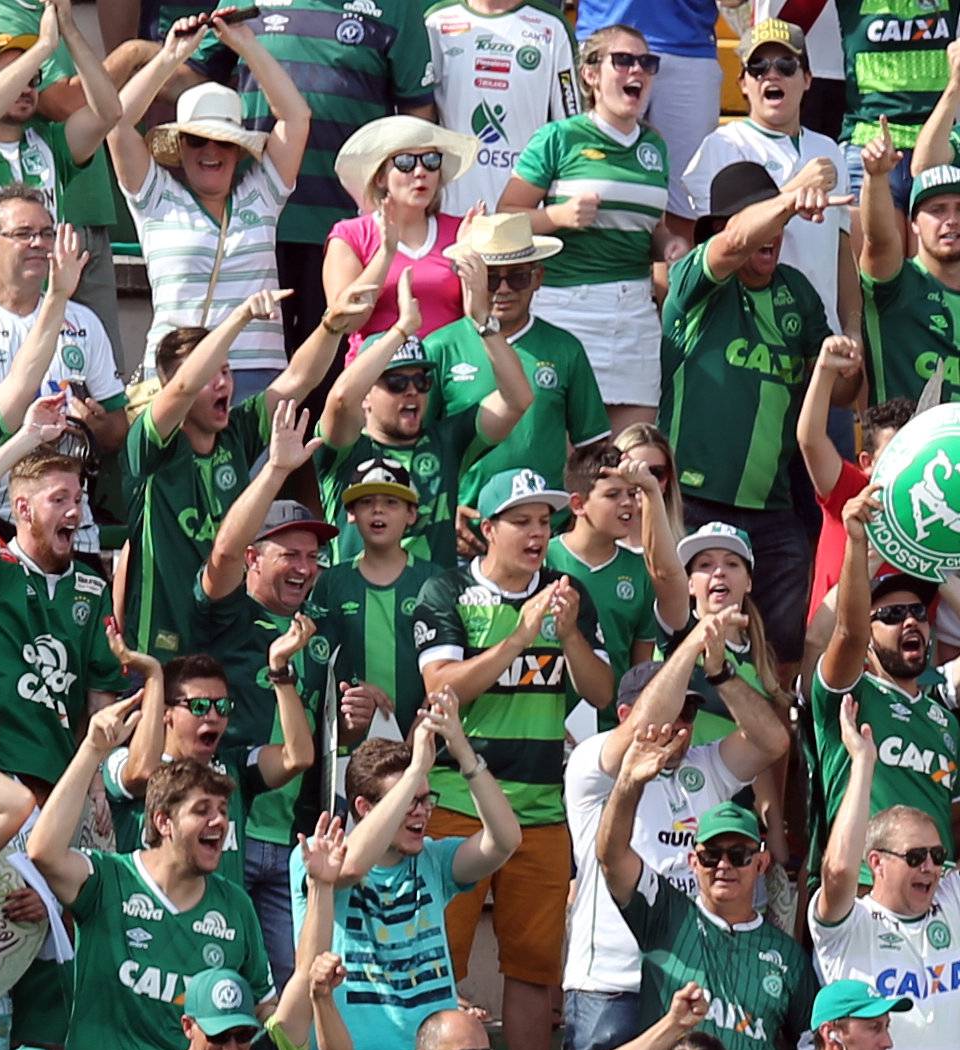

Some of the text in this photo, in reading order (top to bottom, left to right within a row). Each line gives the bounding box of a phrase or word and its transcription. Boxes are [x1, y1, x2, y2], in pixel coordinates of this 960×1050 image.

[751, 28, 790, 44] John
[867, 18, 949, 42] CAIXA
[879, 736, 957, 791] CAIX
[193, 920, 236, 941] aurora
